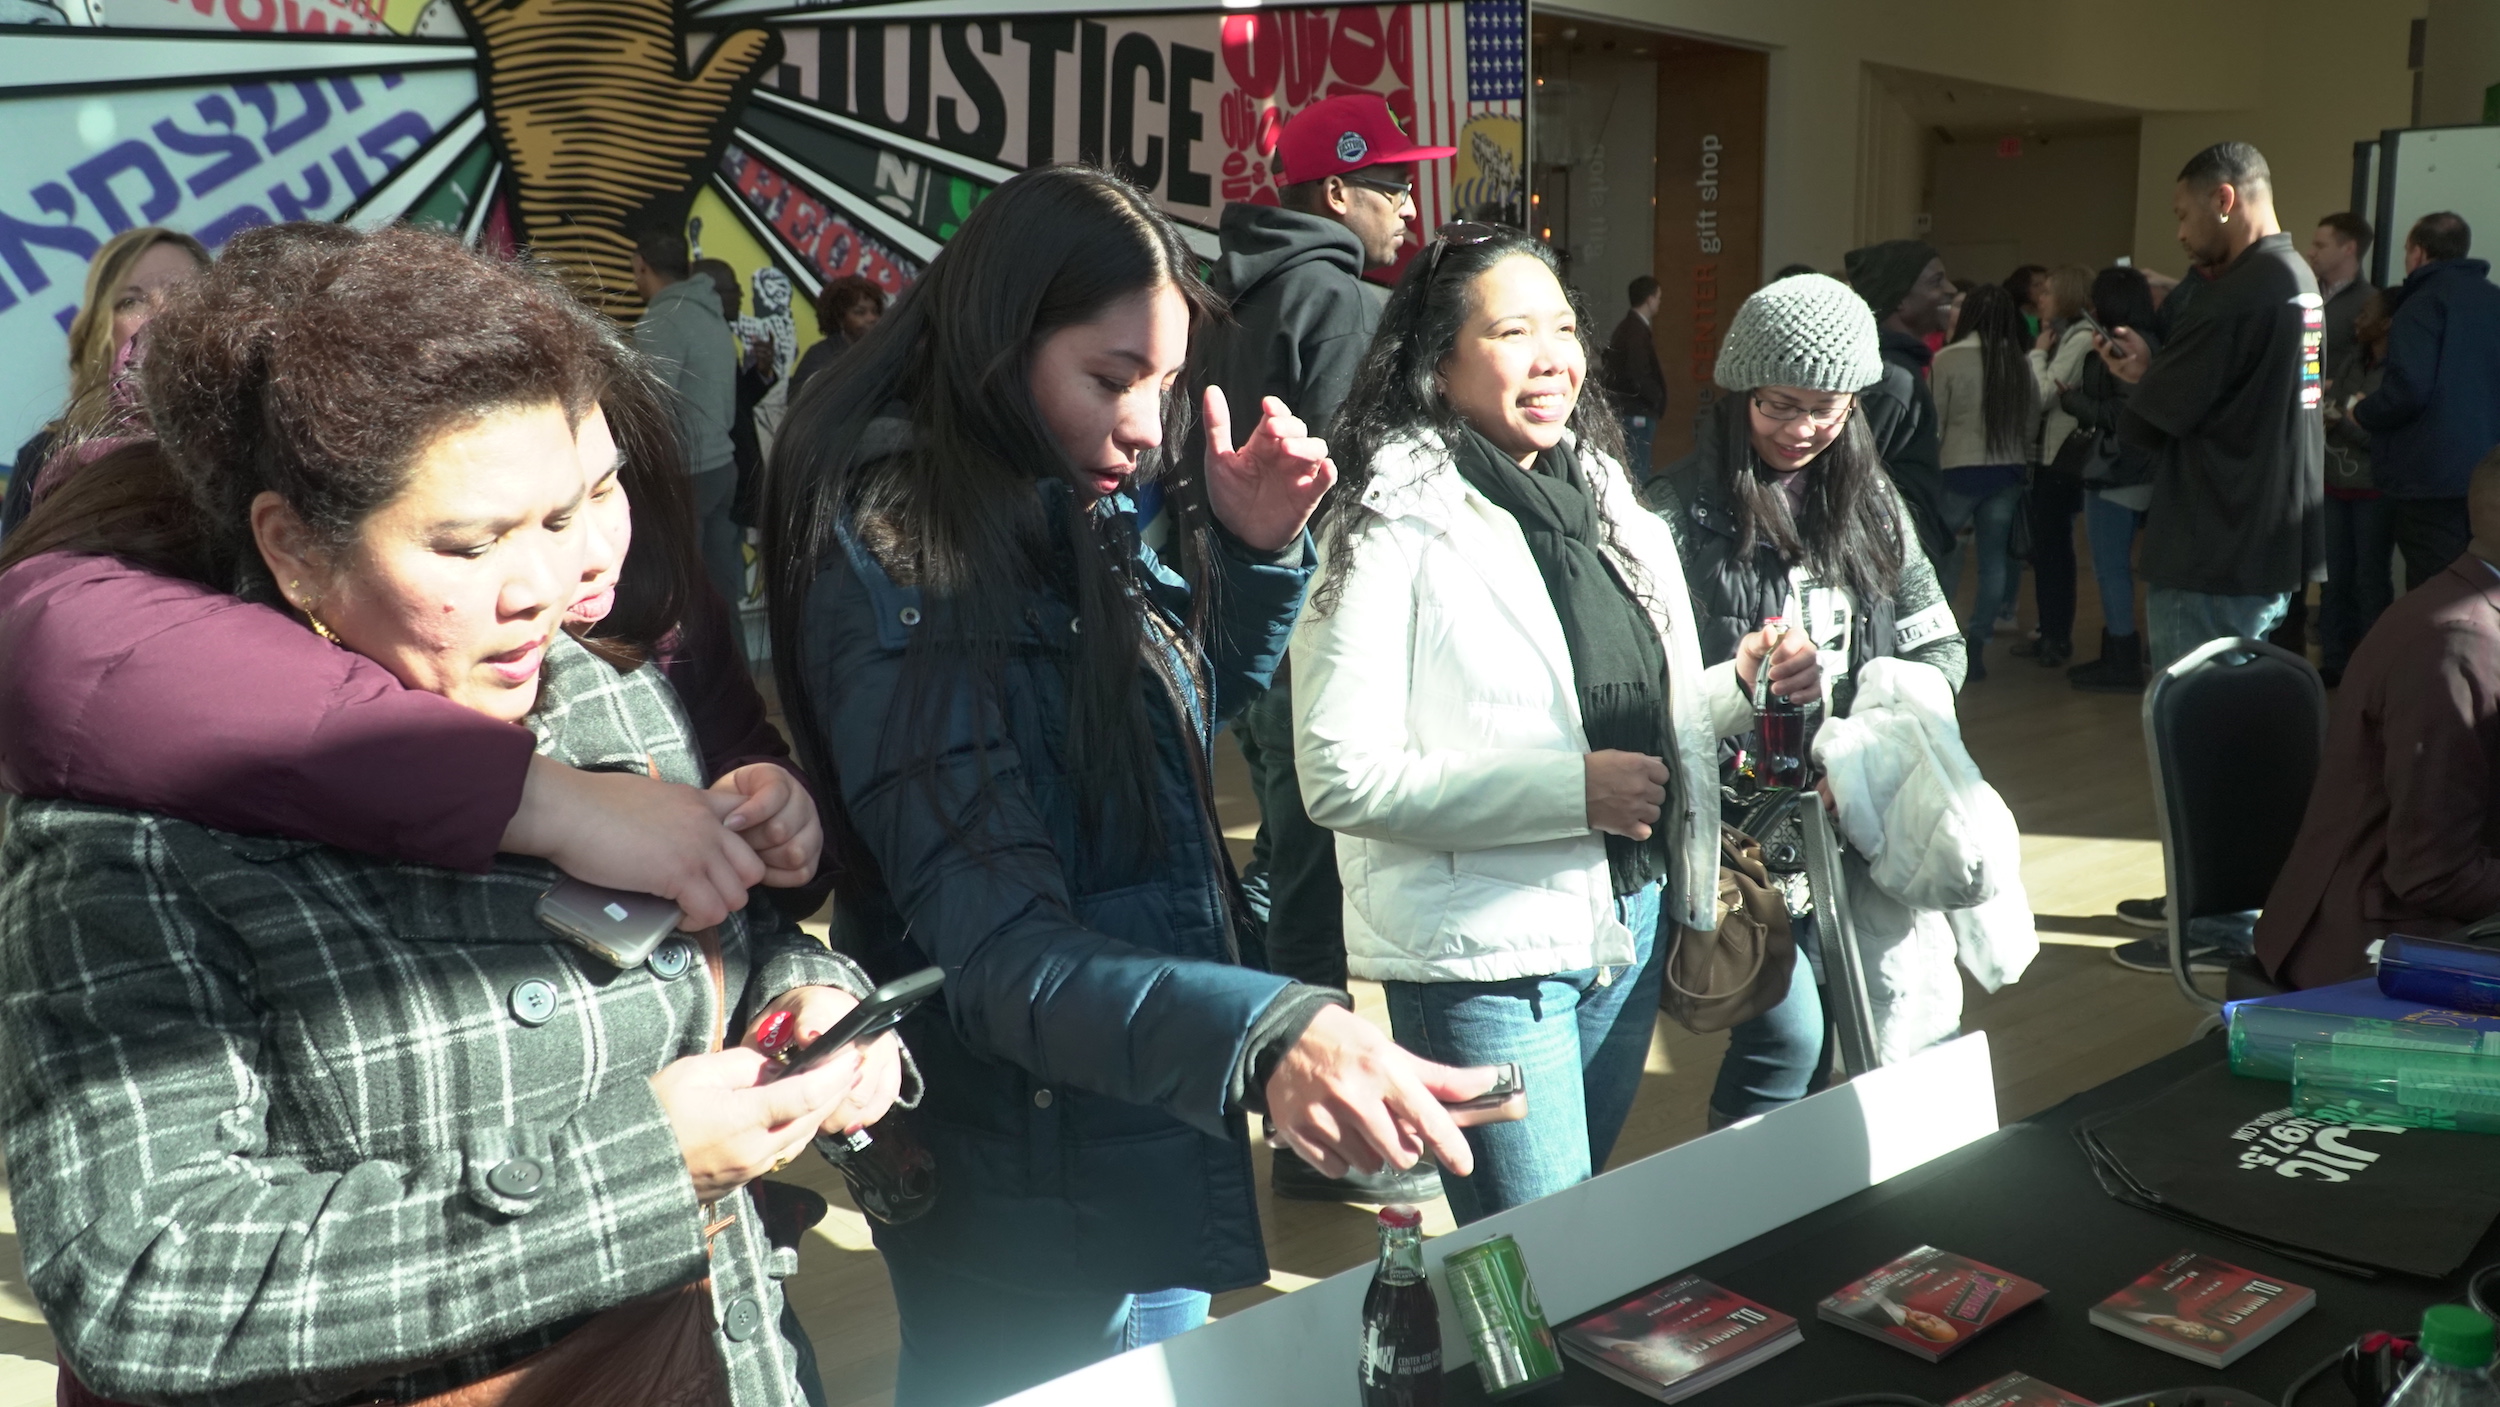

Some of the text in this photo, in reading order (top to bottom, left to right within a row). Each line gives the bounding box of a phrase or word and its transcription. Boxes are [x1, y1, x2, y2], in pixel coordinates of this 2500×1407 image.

[778, 17, 1215, 208] JUSTICE
[1696, 134, 1723, 201] shop
[1696, 209, 1721, 254] gift
[1693, 264, 1717, 381] CENTER
[1397, 1355, 1421, 1367] CENTER
[1397, 1366, 1412, 1376] AND
